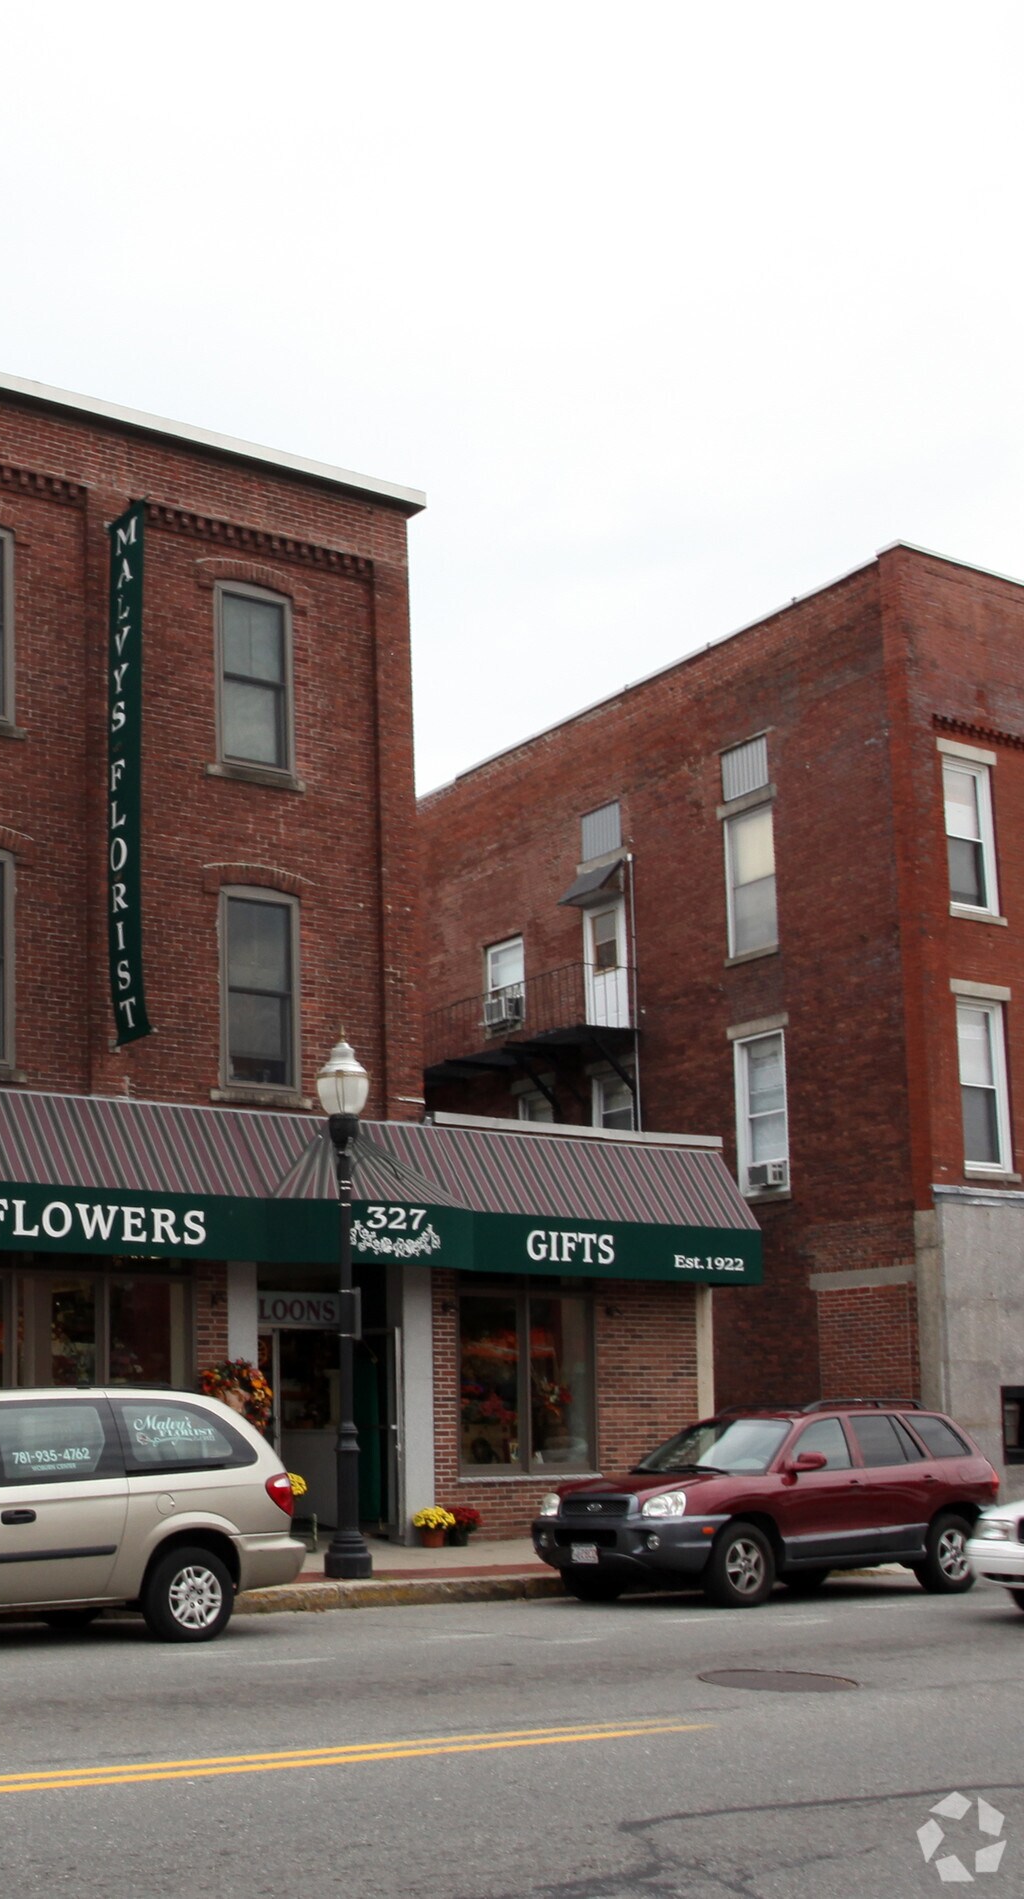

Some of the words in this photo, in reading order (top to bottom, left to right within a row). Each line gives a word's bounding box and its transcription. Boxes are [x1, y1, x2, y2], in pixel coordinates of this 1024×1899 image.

[109, 758, 136, 1029] FLORIST
[366, 1206, 427, 1230] 327
[526, 1230, 615, 1265] GIFTS
[12, 1448, 91, 1465] 781-935-4762
